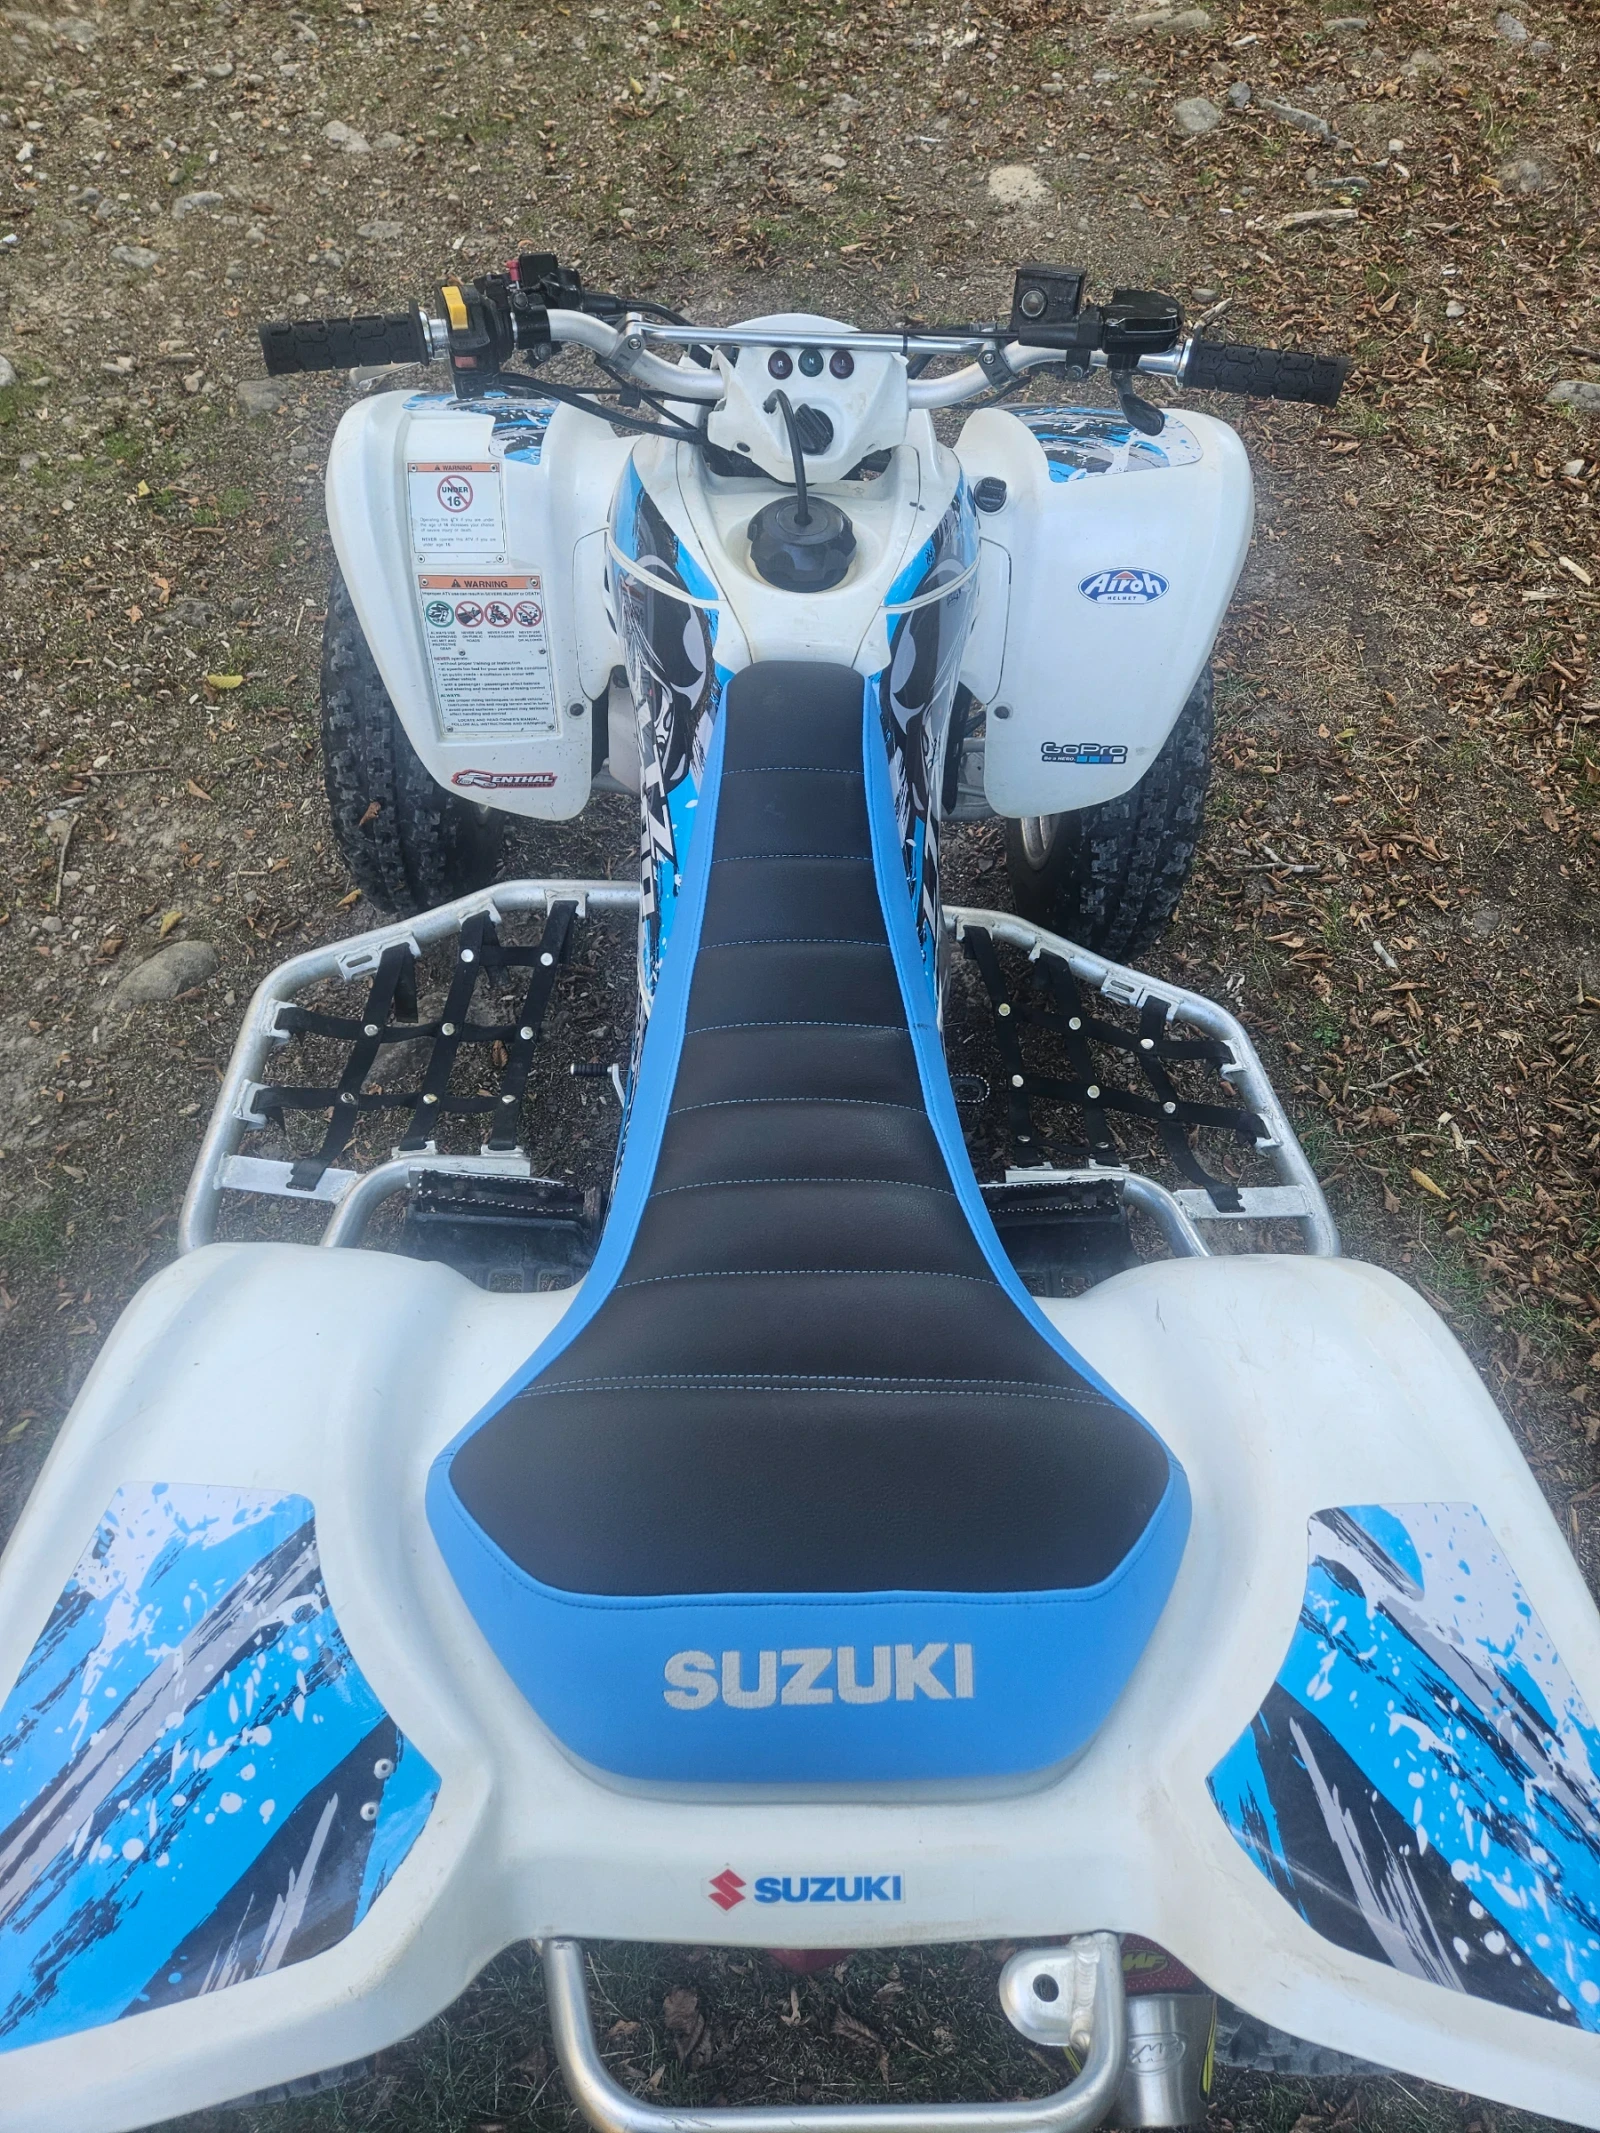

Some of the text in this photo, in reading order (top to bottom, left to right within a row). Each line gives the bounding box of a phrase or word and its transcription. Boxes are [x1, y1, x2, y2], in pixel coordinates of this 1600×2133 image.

[447, 496, 461, 507] 16
[1084, 573, 1162, 595] Airoh
[1043, 744, 1126, 755] GoPro
[663, 1642, 975, 1711] SUZUKI
[754, 1875, 902, 1904] SUZUKI
[1122, 1952, 1167, 1971] MF
